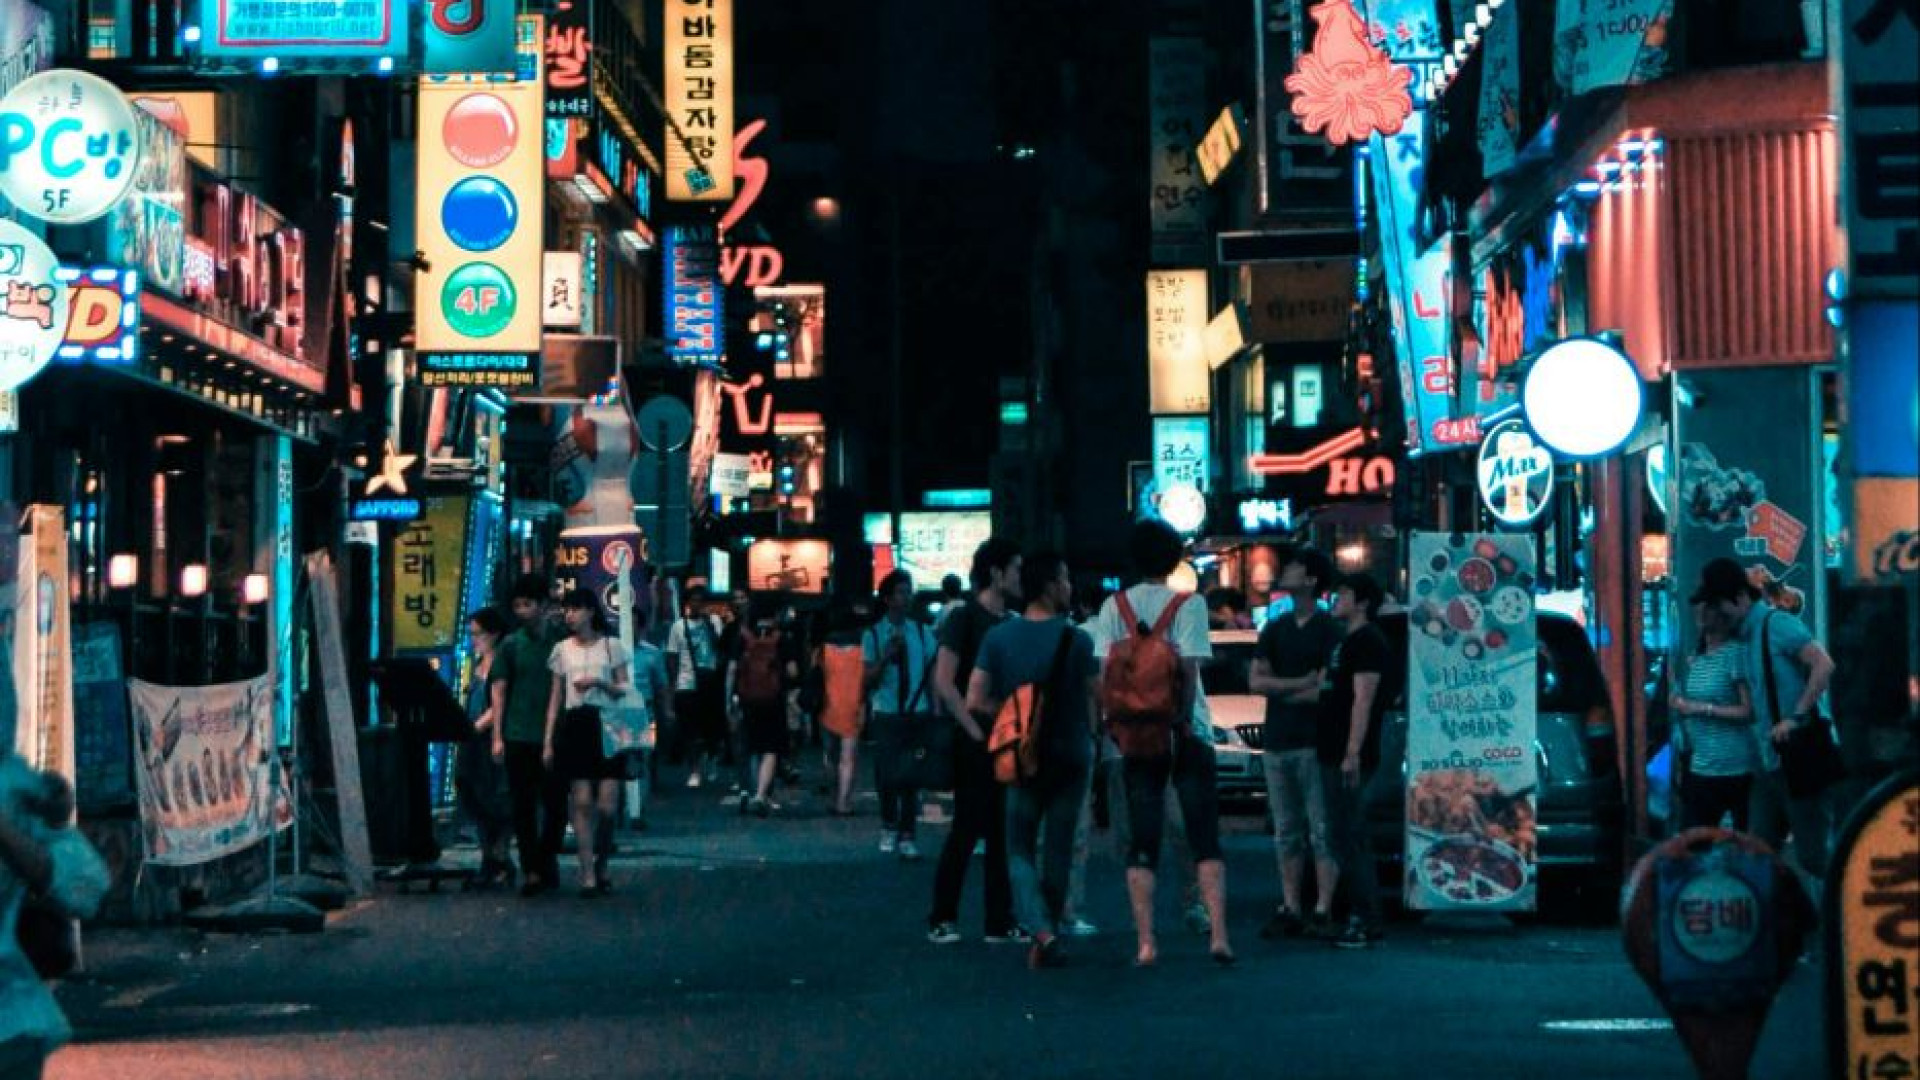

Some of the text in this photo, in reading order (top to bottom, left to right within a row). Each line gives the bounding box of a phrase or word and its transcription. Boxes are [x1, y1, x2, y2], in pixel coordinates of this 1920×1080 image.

[0, 112, 132, 180] PC방
[43, 188, 70, 212] 5F
[455, 286, 500, 315] 4F
